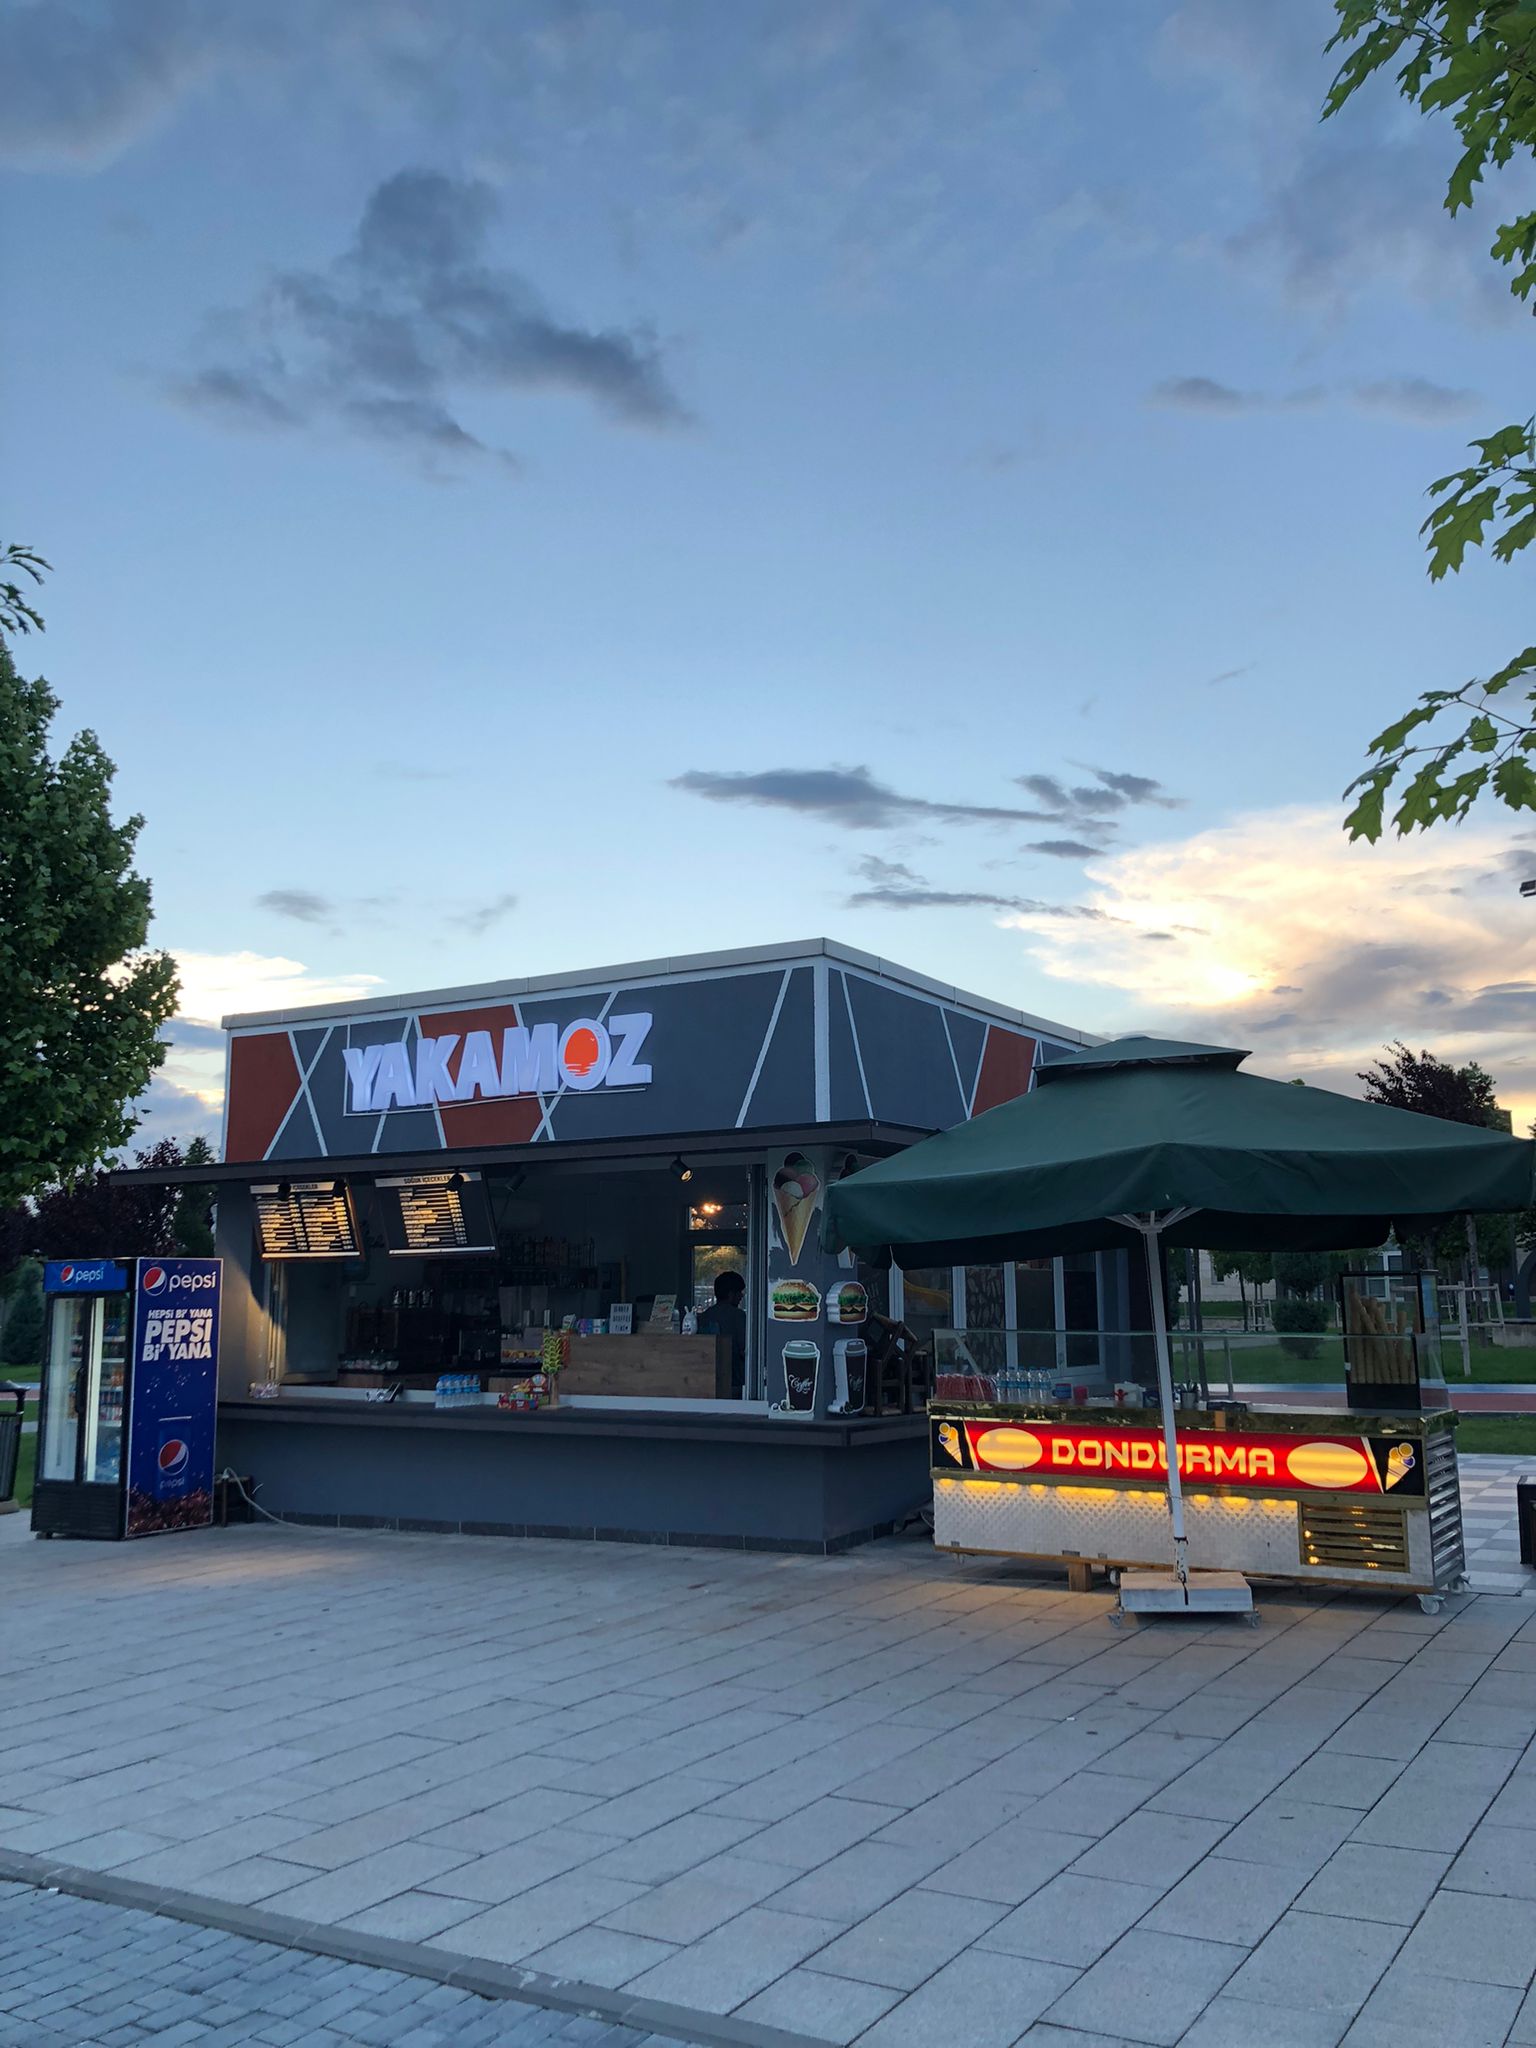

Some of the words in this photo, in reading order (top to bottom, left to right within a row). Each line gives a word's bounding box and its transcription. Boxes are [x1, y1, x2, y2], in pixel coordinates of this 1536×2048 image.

[342, 1012, 653, 1112] YAKAMOZ
[75, 1266, 104, 1284] pepsi
[169, 1271, 217, 1293] pepsi
[189, 1308, 213, 1319] YANA
[144, 1318, 213, 1344] PEPSI
[168, 1342, 212, 1360] YANA
[1051, 1437, 1276, 1478] DONDURMA
